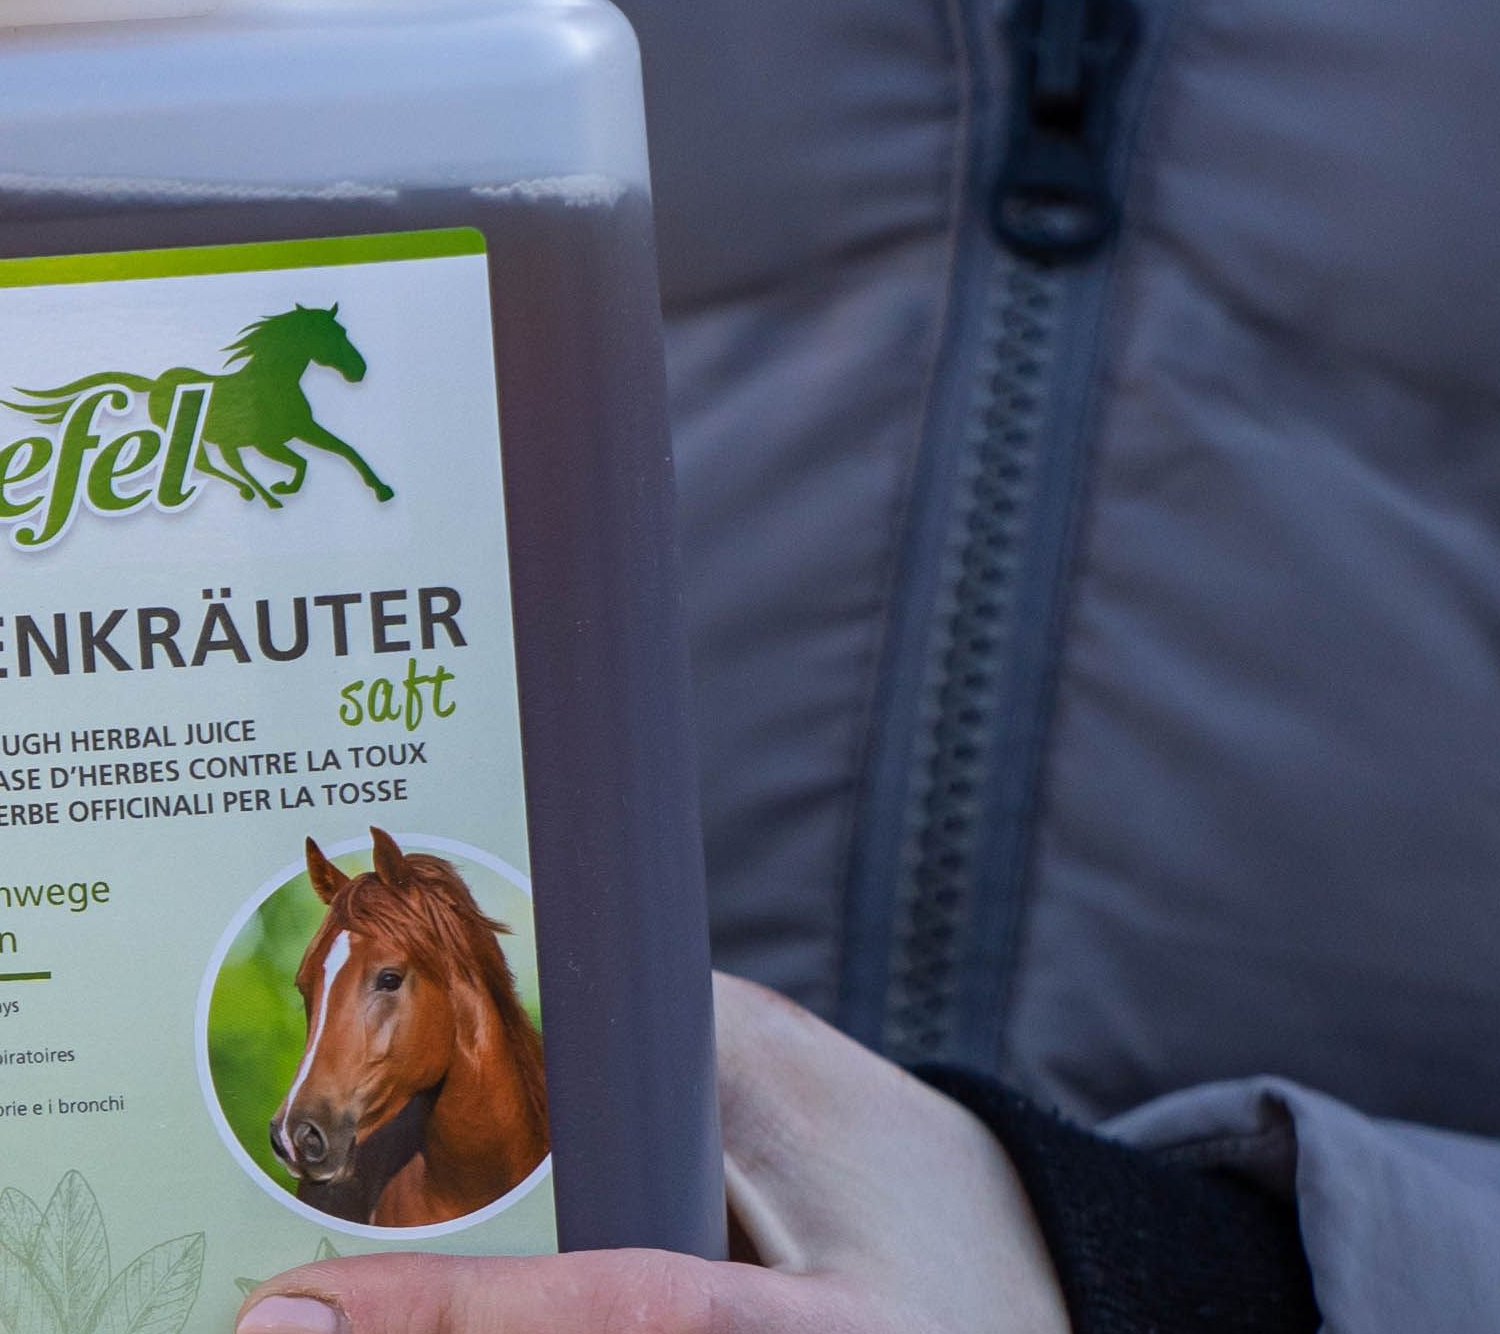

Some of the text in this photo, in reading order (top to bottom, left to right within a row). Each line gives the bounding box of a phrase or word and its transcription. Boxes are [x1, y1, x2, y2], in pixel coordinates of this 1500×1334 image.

[338, 656, 457, 732] saft
[70, 724, 177, 753] HERBAL
[183, 719, 257, 746] JUICE
[49, 759, 180, 789] D’HERBES
[188, 751, 299, 781] CONTRE
[306, 748, 343, 773] LA
[346, 741, 428, 769] TOUX
[68, 792, 215, 823] OFFICINALI
[222, 788, 273, 814] PER
[279, 785, 316, 810] LA
[320, 778, 409, 806] TOSSE
[32, 1103, 44, 1116] e
[48, 1098, 53, 1115] i
[58, 1094, 125, 1115] bronchi
